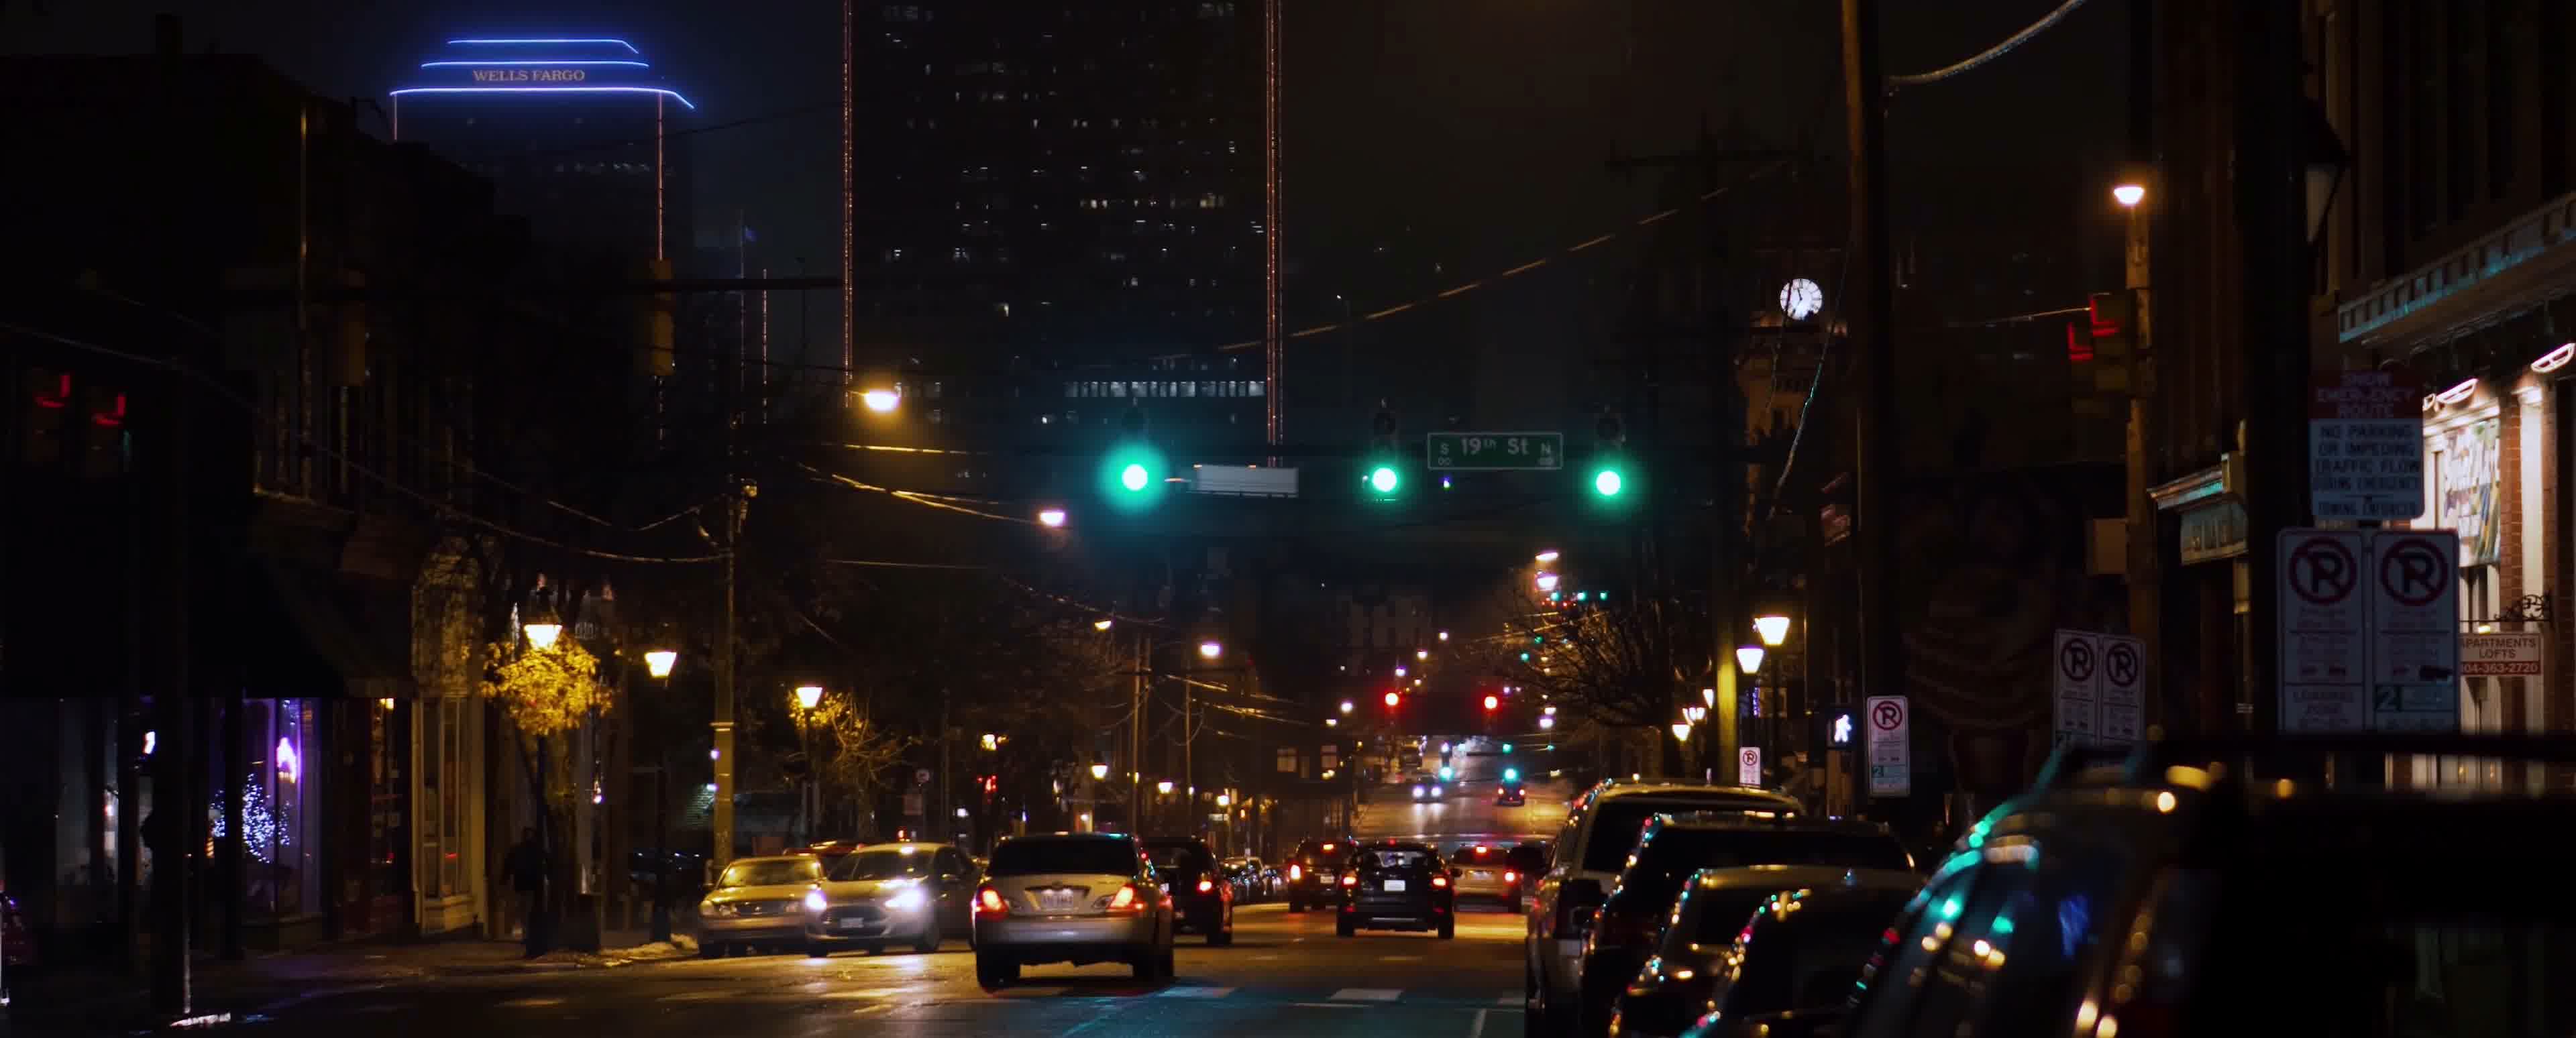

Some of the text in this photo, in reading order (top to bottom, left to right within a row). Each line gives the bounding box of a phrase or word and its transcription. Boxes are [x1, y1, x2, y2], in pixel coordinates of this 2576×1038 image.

[472, 69, 586, 81] WELLS FARGO
[2316, 388, 2416, 403] EMERGENCY
[2338, 404, 2394, 419] ROUTE
[2320, 424, 2413, 439] NO PARKING
[1440, 437, 1552, 456] S 19th St N
[2318, 441, 2415, 457] OR IMPEDING
[2316, 459, 2419, 473] TRAFFIC FLOW
[2479, 648, 2517, 659] LOFTS
[2463, 662, 2538, 673] 04-363-2720
